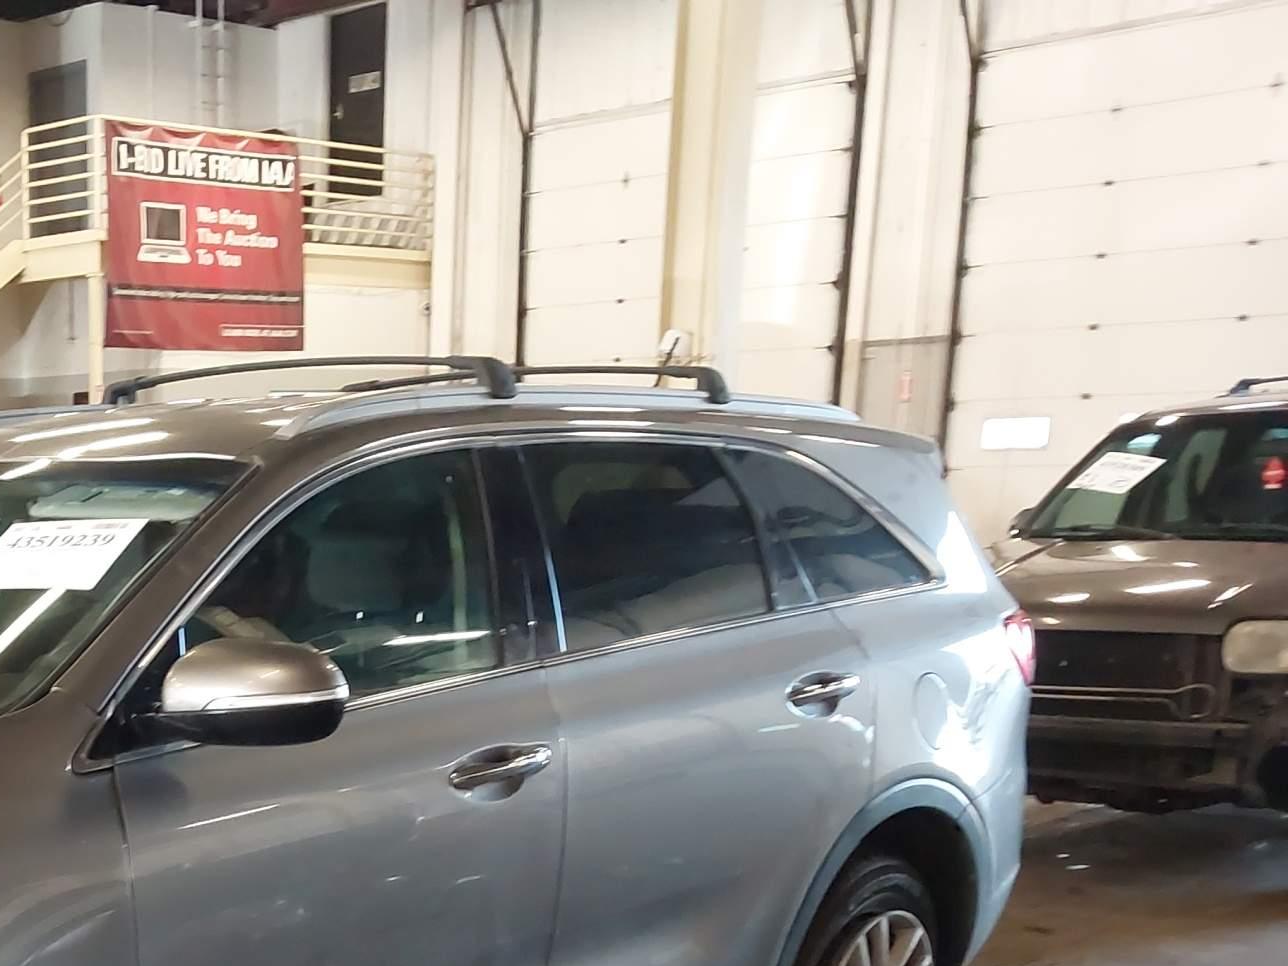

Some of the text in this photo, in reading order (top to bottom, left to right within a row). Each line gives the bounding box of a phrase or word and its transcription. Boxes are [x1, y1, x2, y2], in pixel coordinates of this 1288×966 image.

[167, 150, 207, 178] LIVE
[208, 154, 259, 184] FROM
[195, 206, 258, 230] We Bring
[195, 227, 279, 249] The Auction
[195, 248, 242, 267] To You
[7, 533, 117, 549] 43519239
